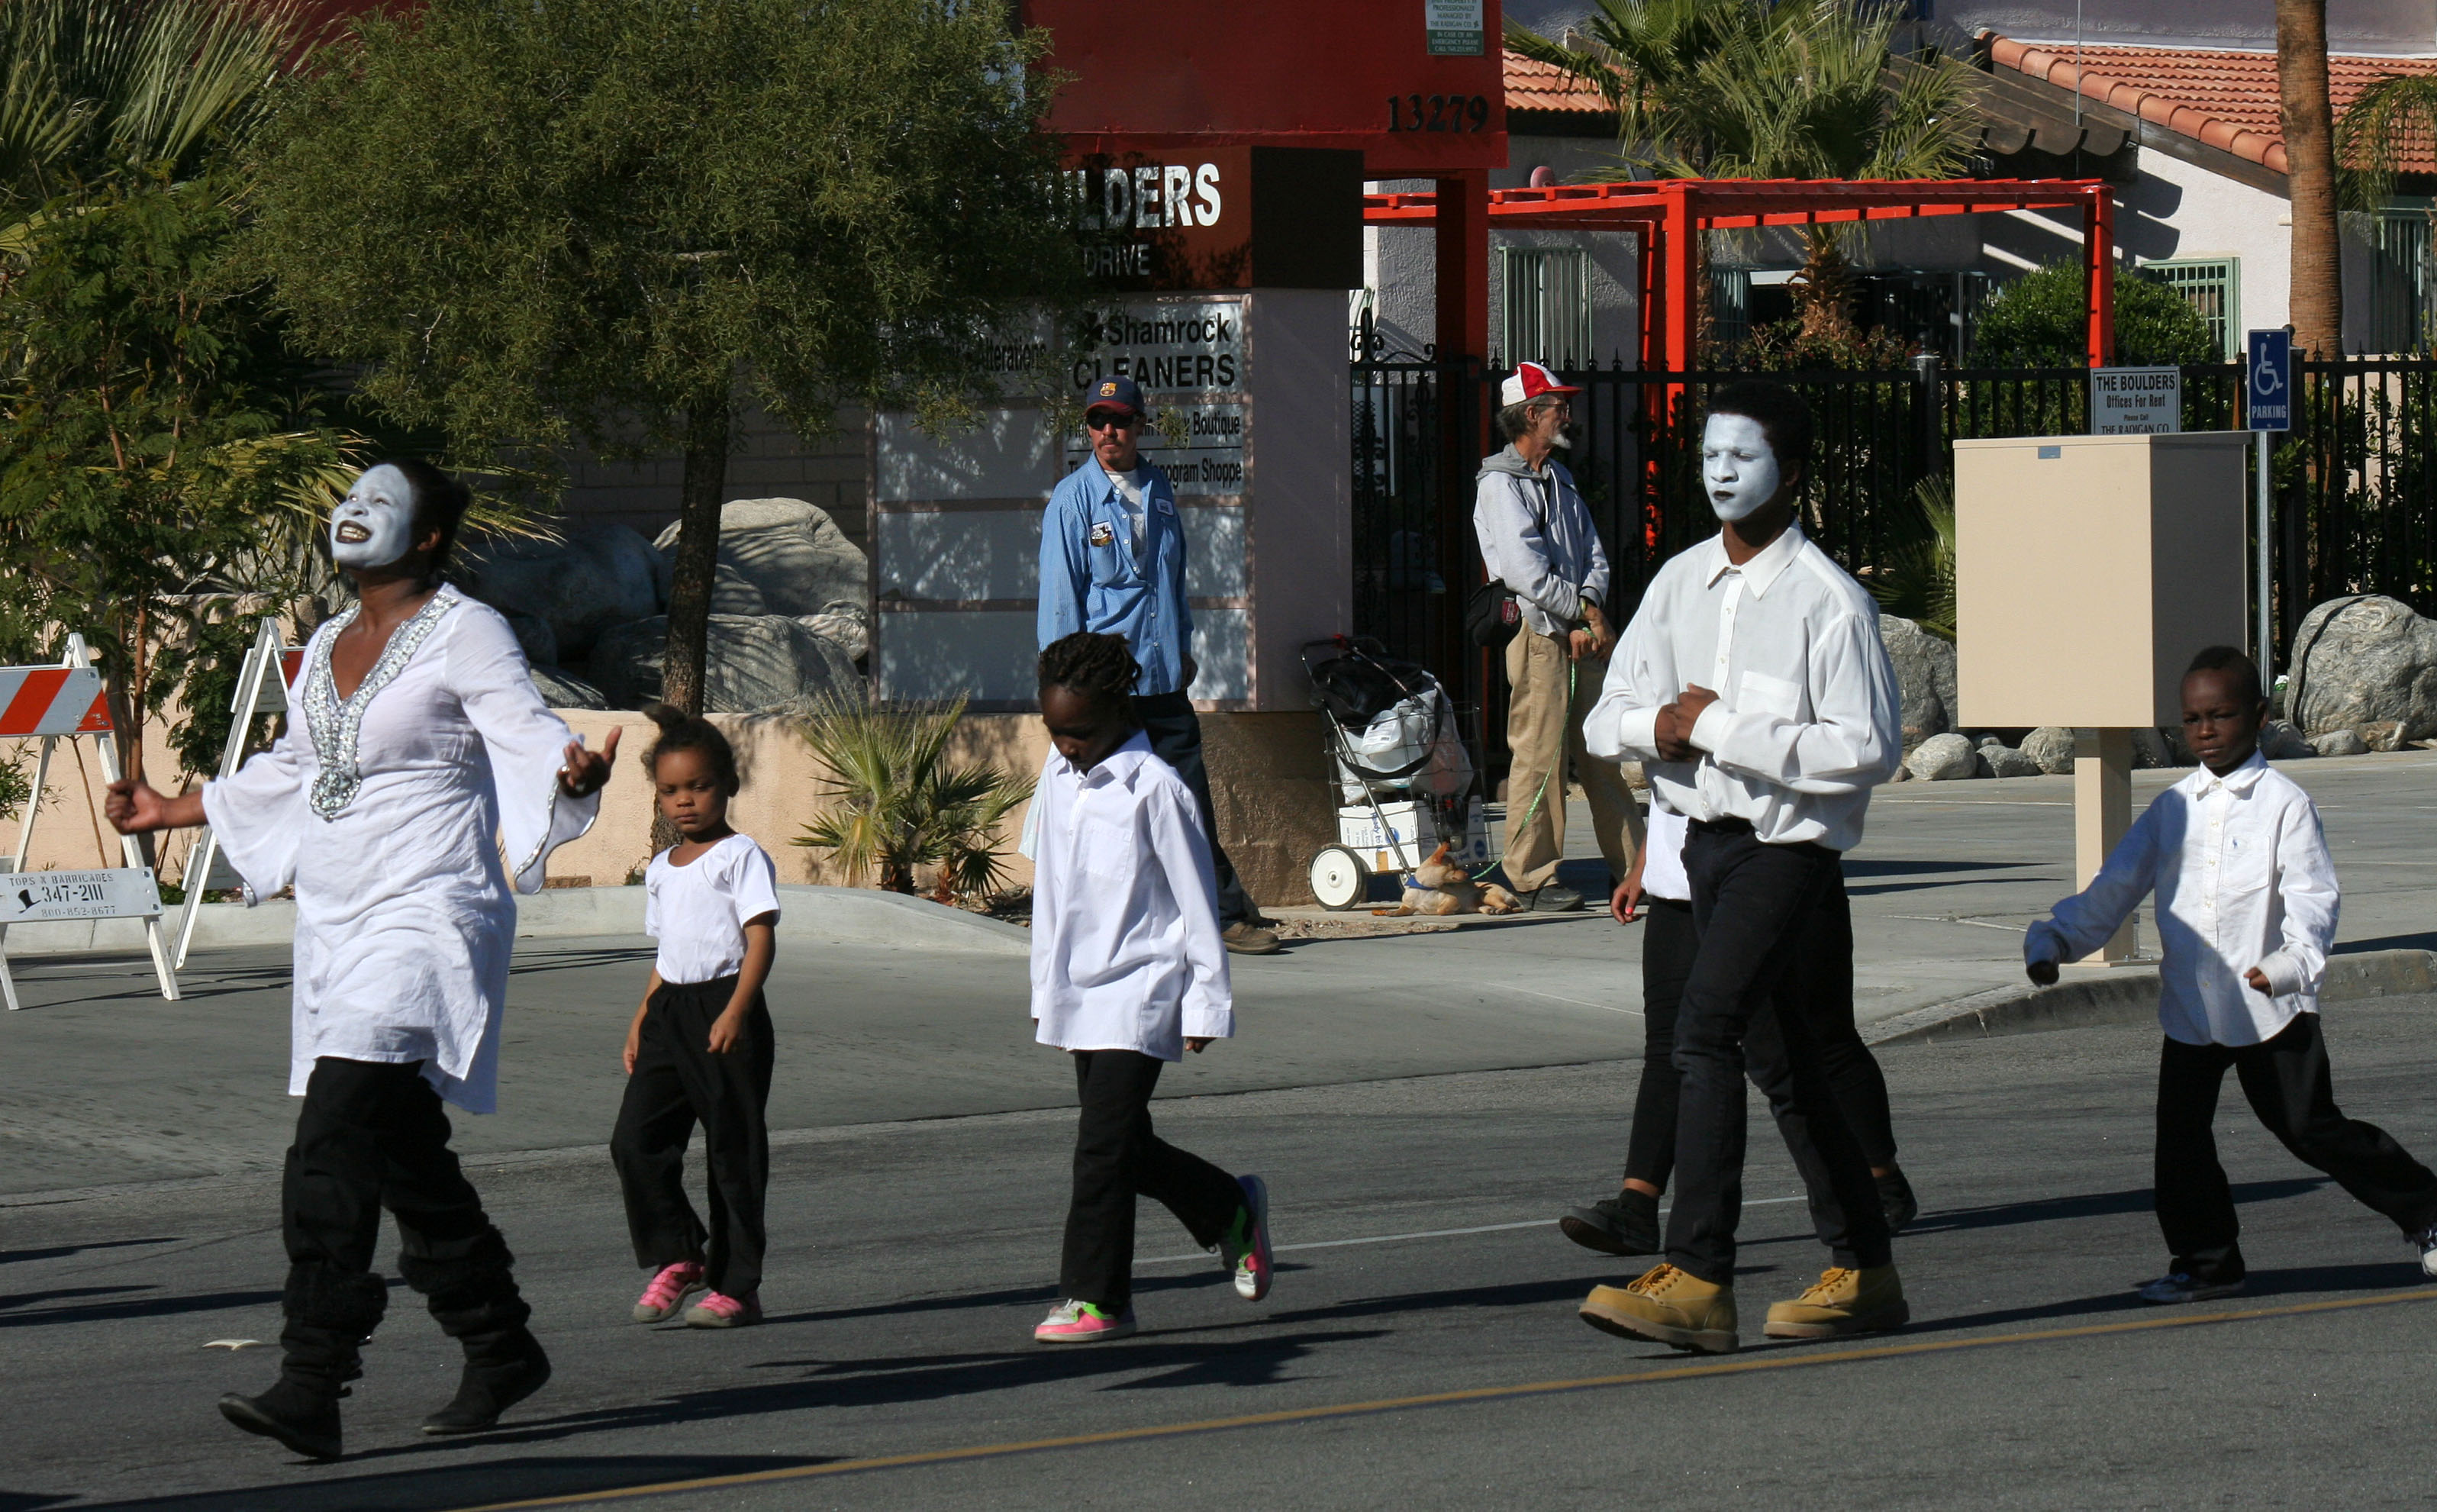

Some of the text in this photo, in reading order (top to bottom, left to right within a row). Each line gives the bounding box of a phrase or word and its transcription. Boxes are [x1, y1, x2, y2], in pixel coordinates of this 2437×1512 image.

[1386, 94, 1489, 133] 13279
[1084, 243, 1151, 277] DRIVE
[1107, 312, 1231, 345] Shamrock
[980, 336, 1047, 372] lterations
[2096, 374, 2175, 392] THE BOULDERS
[2107, 393, 2165, 409] Offices For Rent
[2252, 405, 2287, 419] PARKING
[1193, 411, 1240, 440] Boutique
[2101, 425, 2116, 434] THE
[1201, 457, 1242, 488] Shoppe
[9, 876, 35, 886] TOPS
[52, 873, 114, 885] BARRICADES
[42, 884, 104, 902] 347-2111
[41, 905, 114, 917] 800-852-8677
